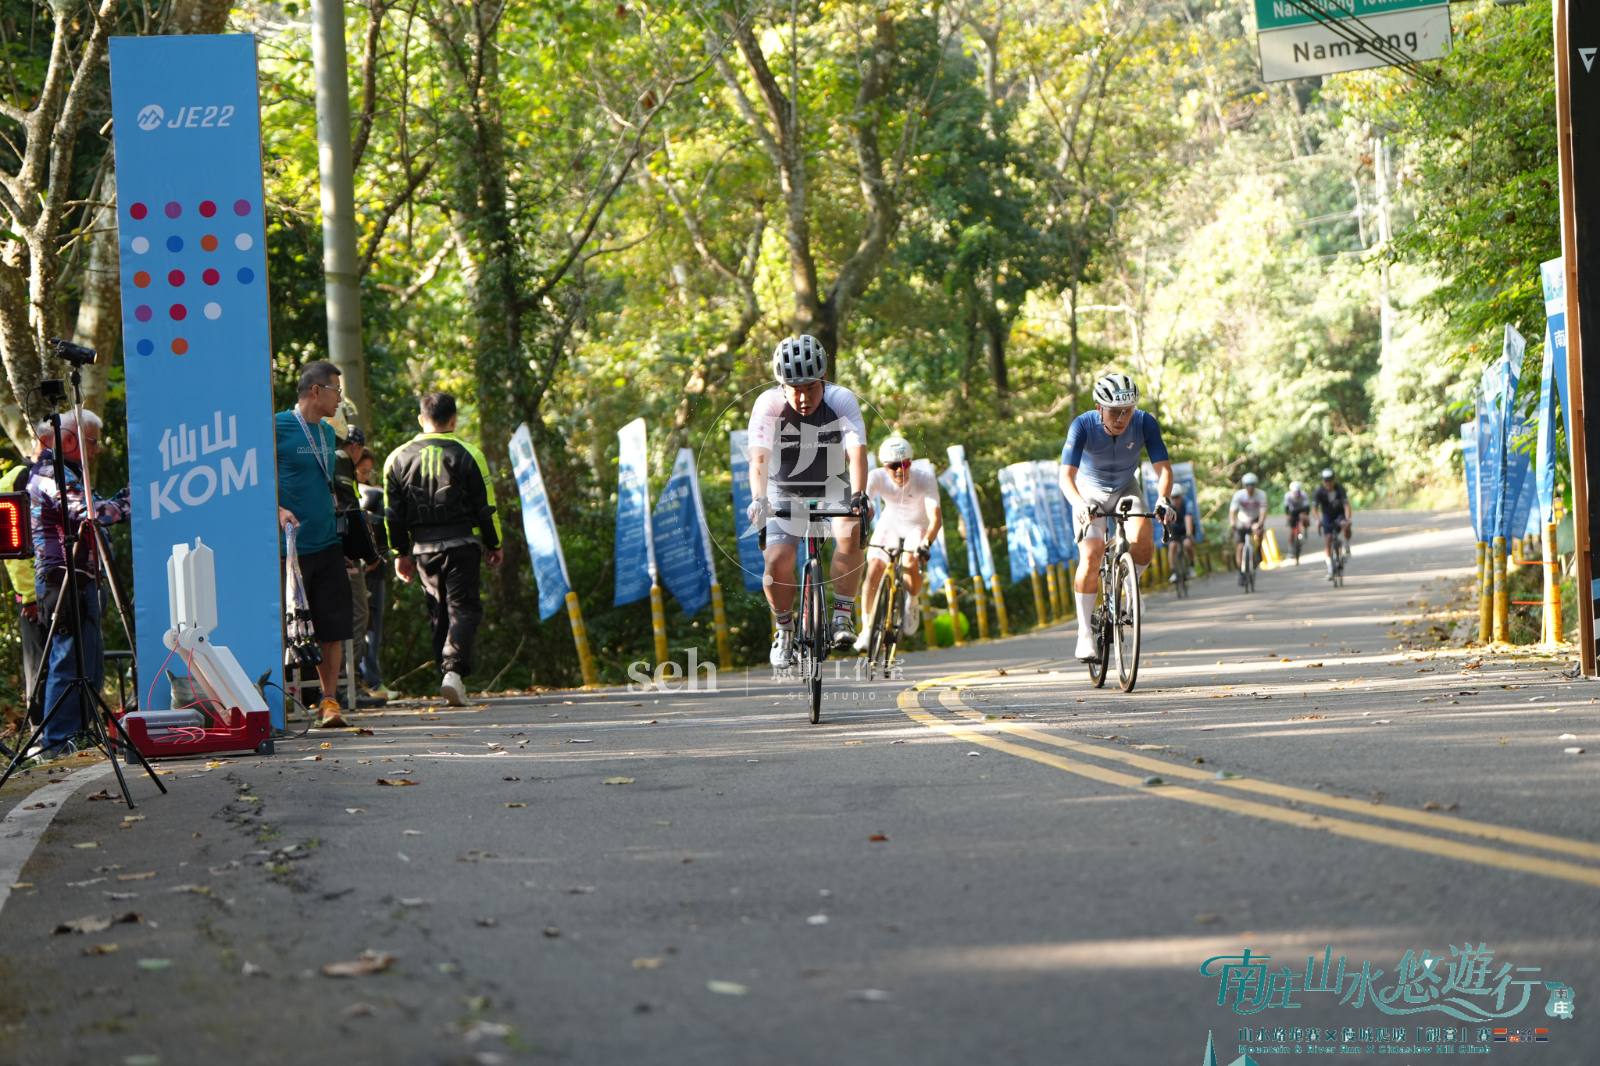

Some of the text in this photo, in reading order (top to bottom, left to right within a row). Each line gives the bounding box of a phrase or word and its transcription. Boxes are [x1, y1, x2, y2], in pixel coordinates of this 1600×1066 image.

[1293, 31, 1418, 63] Namzong
[167, 105, 235, 129] JE22
[158, 410, 237, 471] 仙山
[150, 447, 259, 520] KOM
